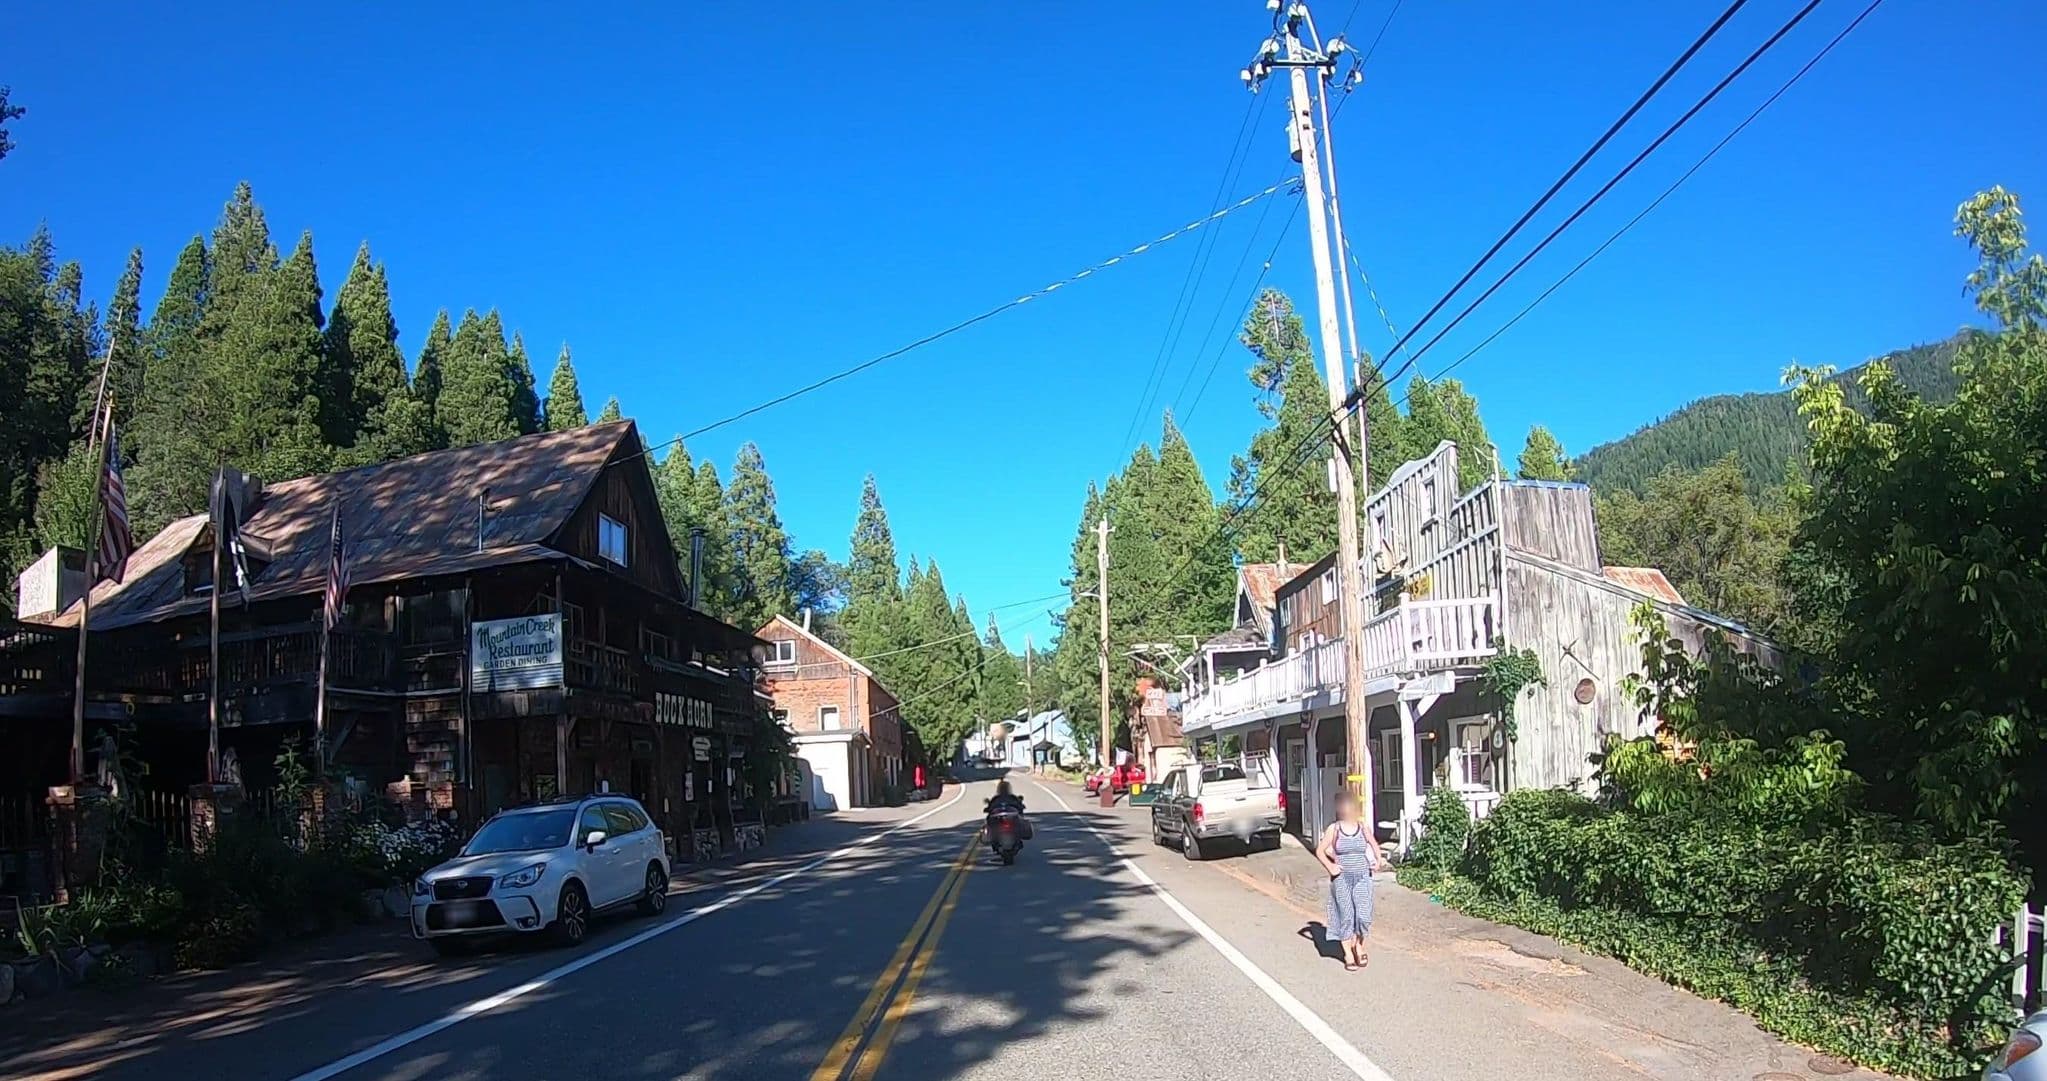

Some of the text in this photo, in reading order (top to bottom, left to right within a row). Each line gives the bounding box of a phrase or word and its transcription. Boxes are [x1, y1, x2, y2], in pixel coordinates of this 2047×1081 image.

[477, 618, 555, 649] Mountain Creek
[489, 638, 555, 660] Restaurant
[484, 656, 548, 669] GARDEN DINING
